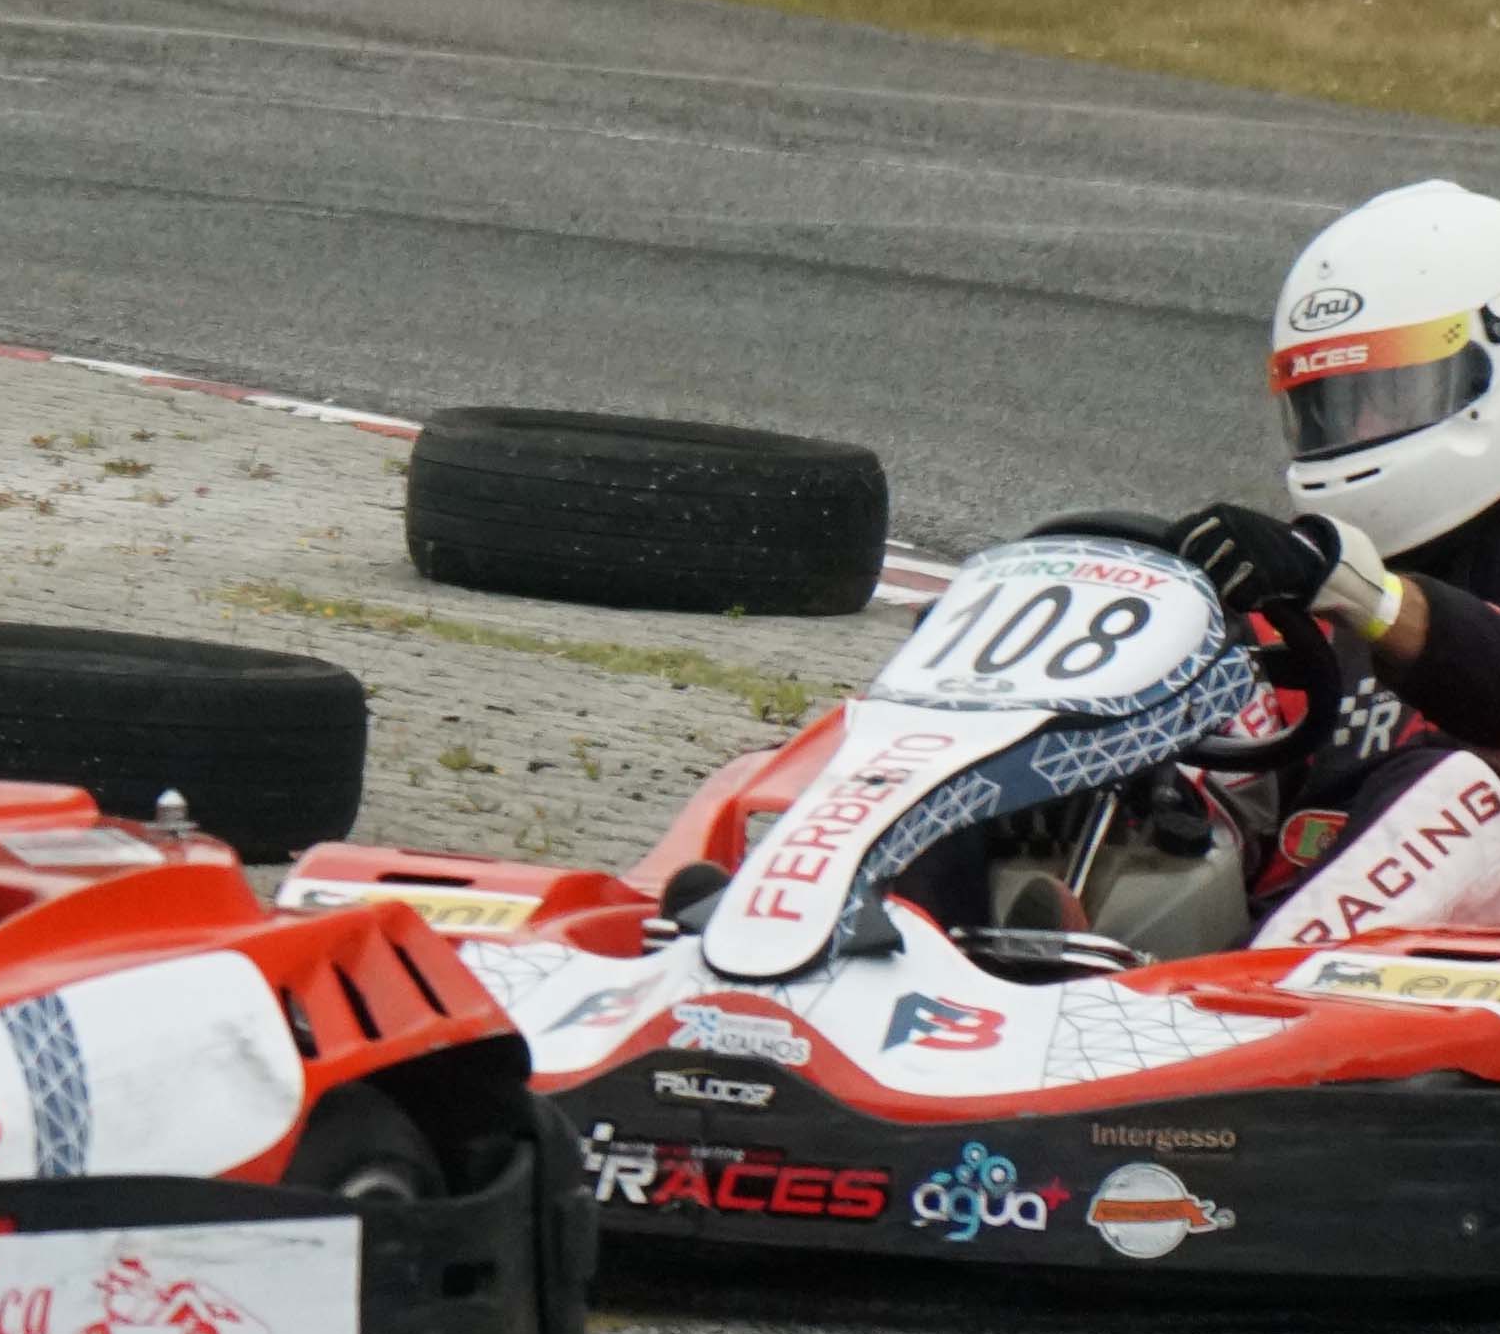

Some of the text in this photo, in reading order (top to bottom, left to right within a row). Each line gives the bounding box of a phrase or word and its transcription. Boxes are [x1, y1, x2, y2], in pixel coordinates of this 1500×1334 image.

[1284, 344, 1369, 378] ACES
[921, 584, 1152, 680] 108
[745, 732, 957, 923] FERBERTO
[1091, 1122, 1237, 1151] Intergesso
